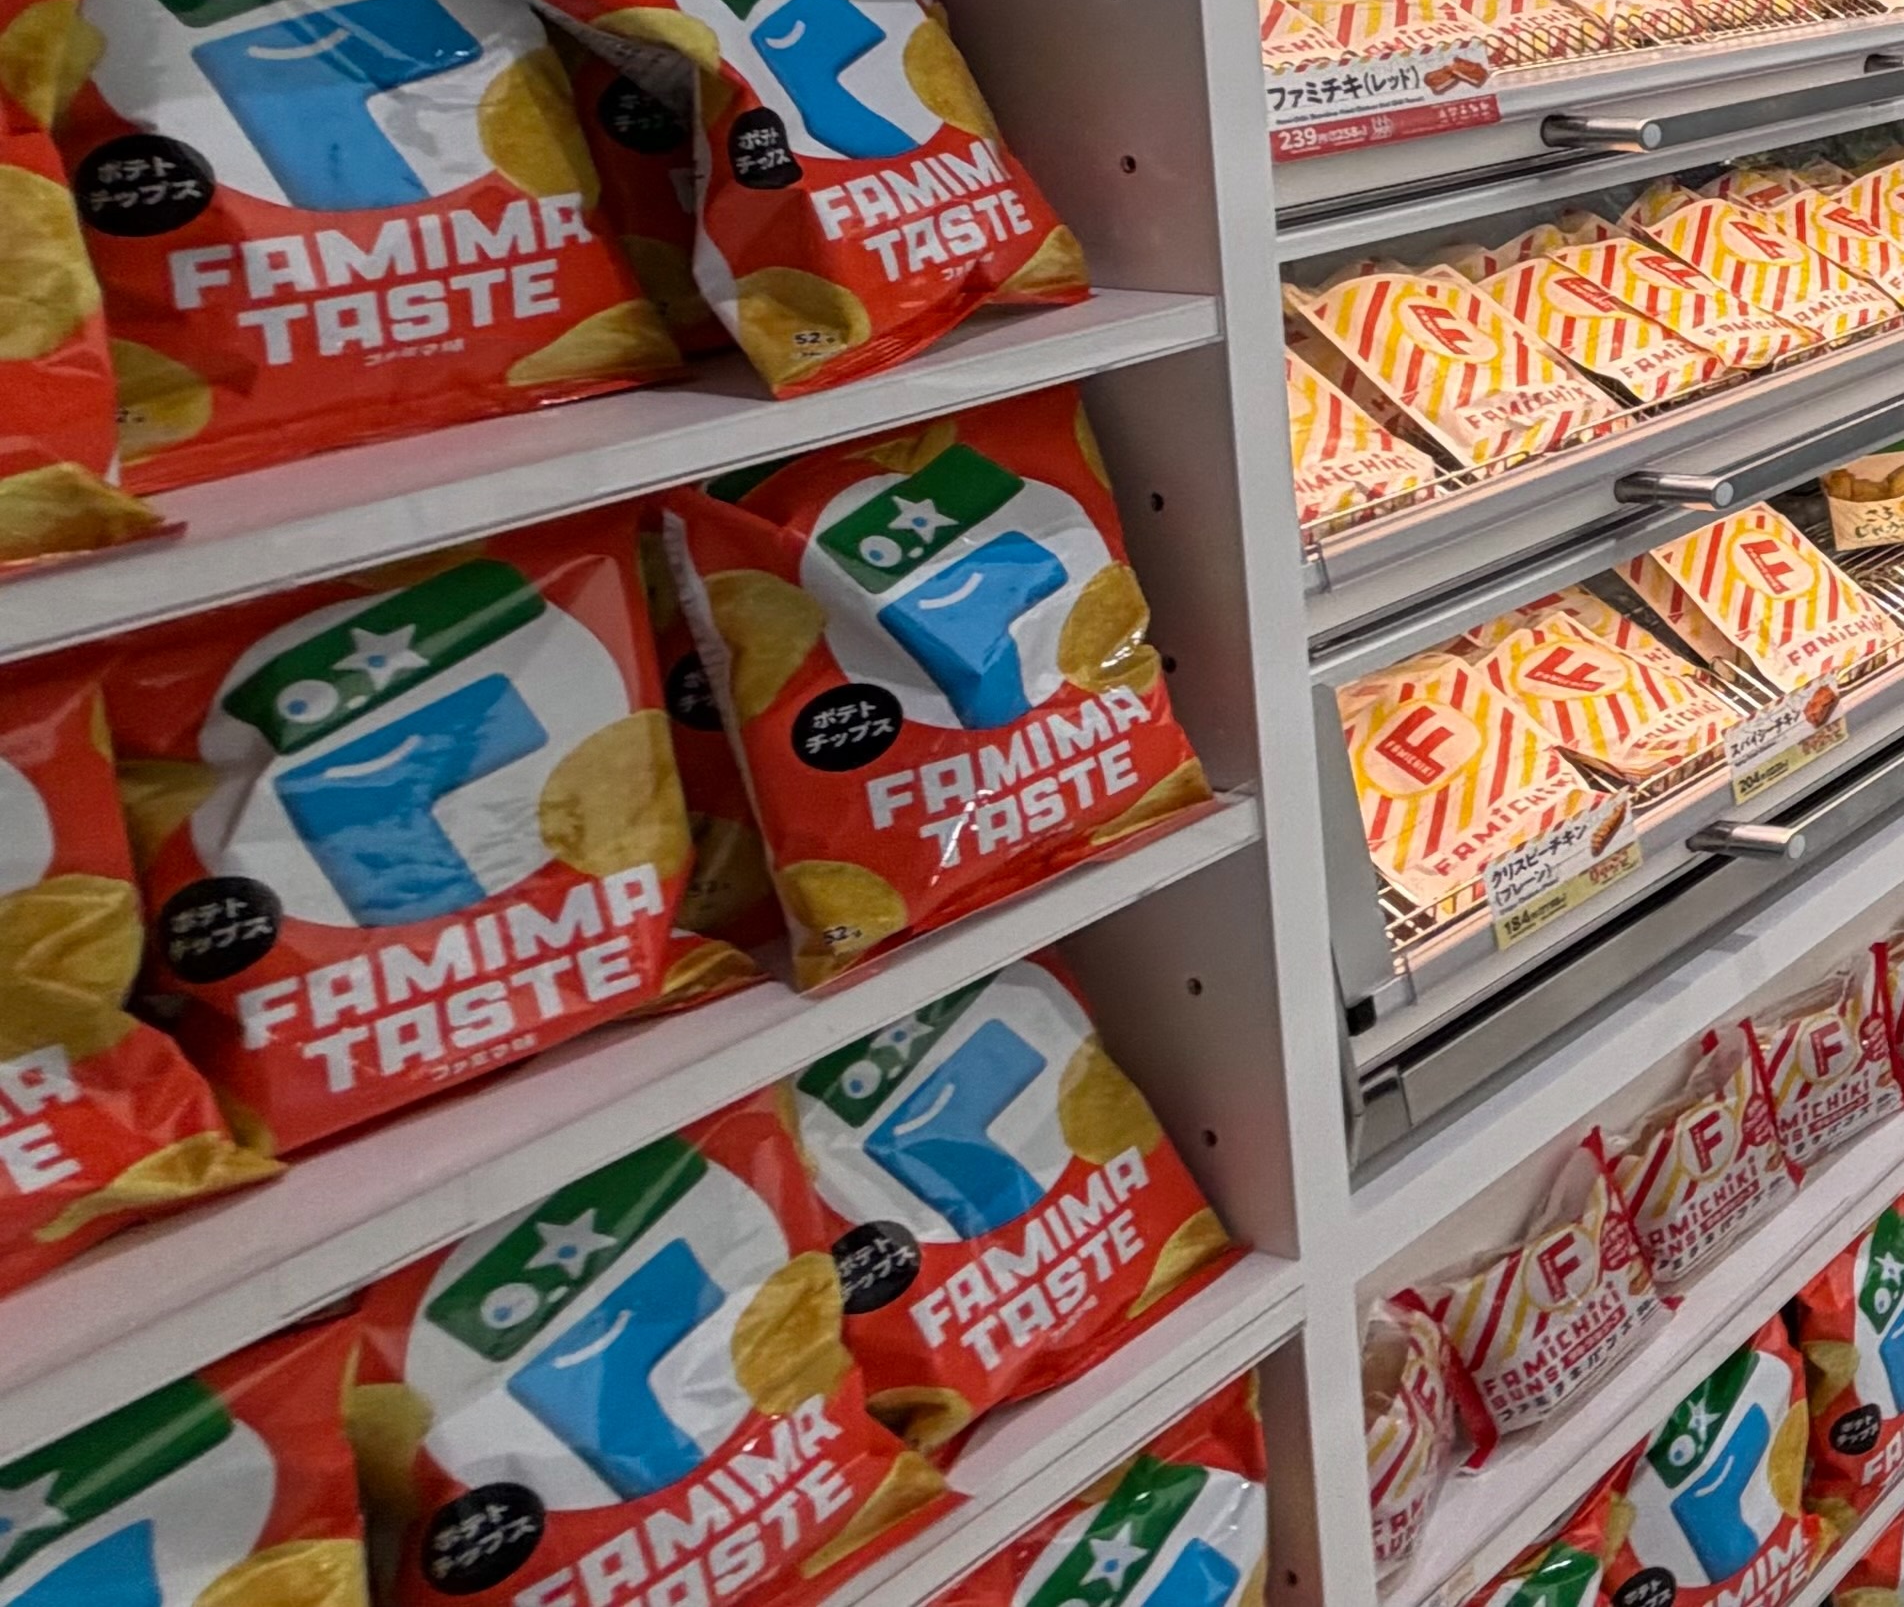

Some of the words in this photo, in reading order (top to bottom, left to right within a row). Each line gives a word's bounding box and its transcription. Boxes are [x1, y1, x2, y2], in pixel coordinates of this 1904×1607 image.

[1266, 64, 1421, 112] ファミチキ(レッド)
[94, 152, 175, 184] ポテト
[1278, 126, 1318, 151] 239
[86, 177, 204, 210] チップス
[167, 194, 596, 310] FAMIMA
[862, 192, 1034, 285] TASTE
[236, 260, 563, 366] TASTE
[801, 715, 898, 757] チップス
[809, 697, 879, 733] ポテト
[865, 685, 1151, 831] FAMIMA
[1738, 773, 1762, 795] 204
[918, 742, 1142, 892] TASTE
[1490, 823, 1589, 888] クリスピーチキン
[1503, 907, 1531, 935] 184
[238, 859, 666, 1052] FAMIMA
[302, 934, 643, 1097] TASTE
[908, 1144, 1149, 1353] FAMIMA
[958, 1207, 1147, 1373] TASTE
[428, 1519, 547, 1580] チップス
[432, 1509, 515, 1554] ポテト
